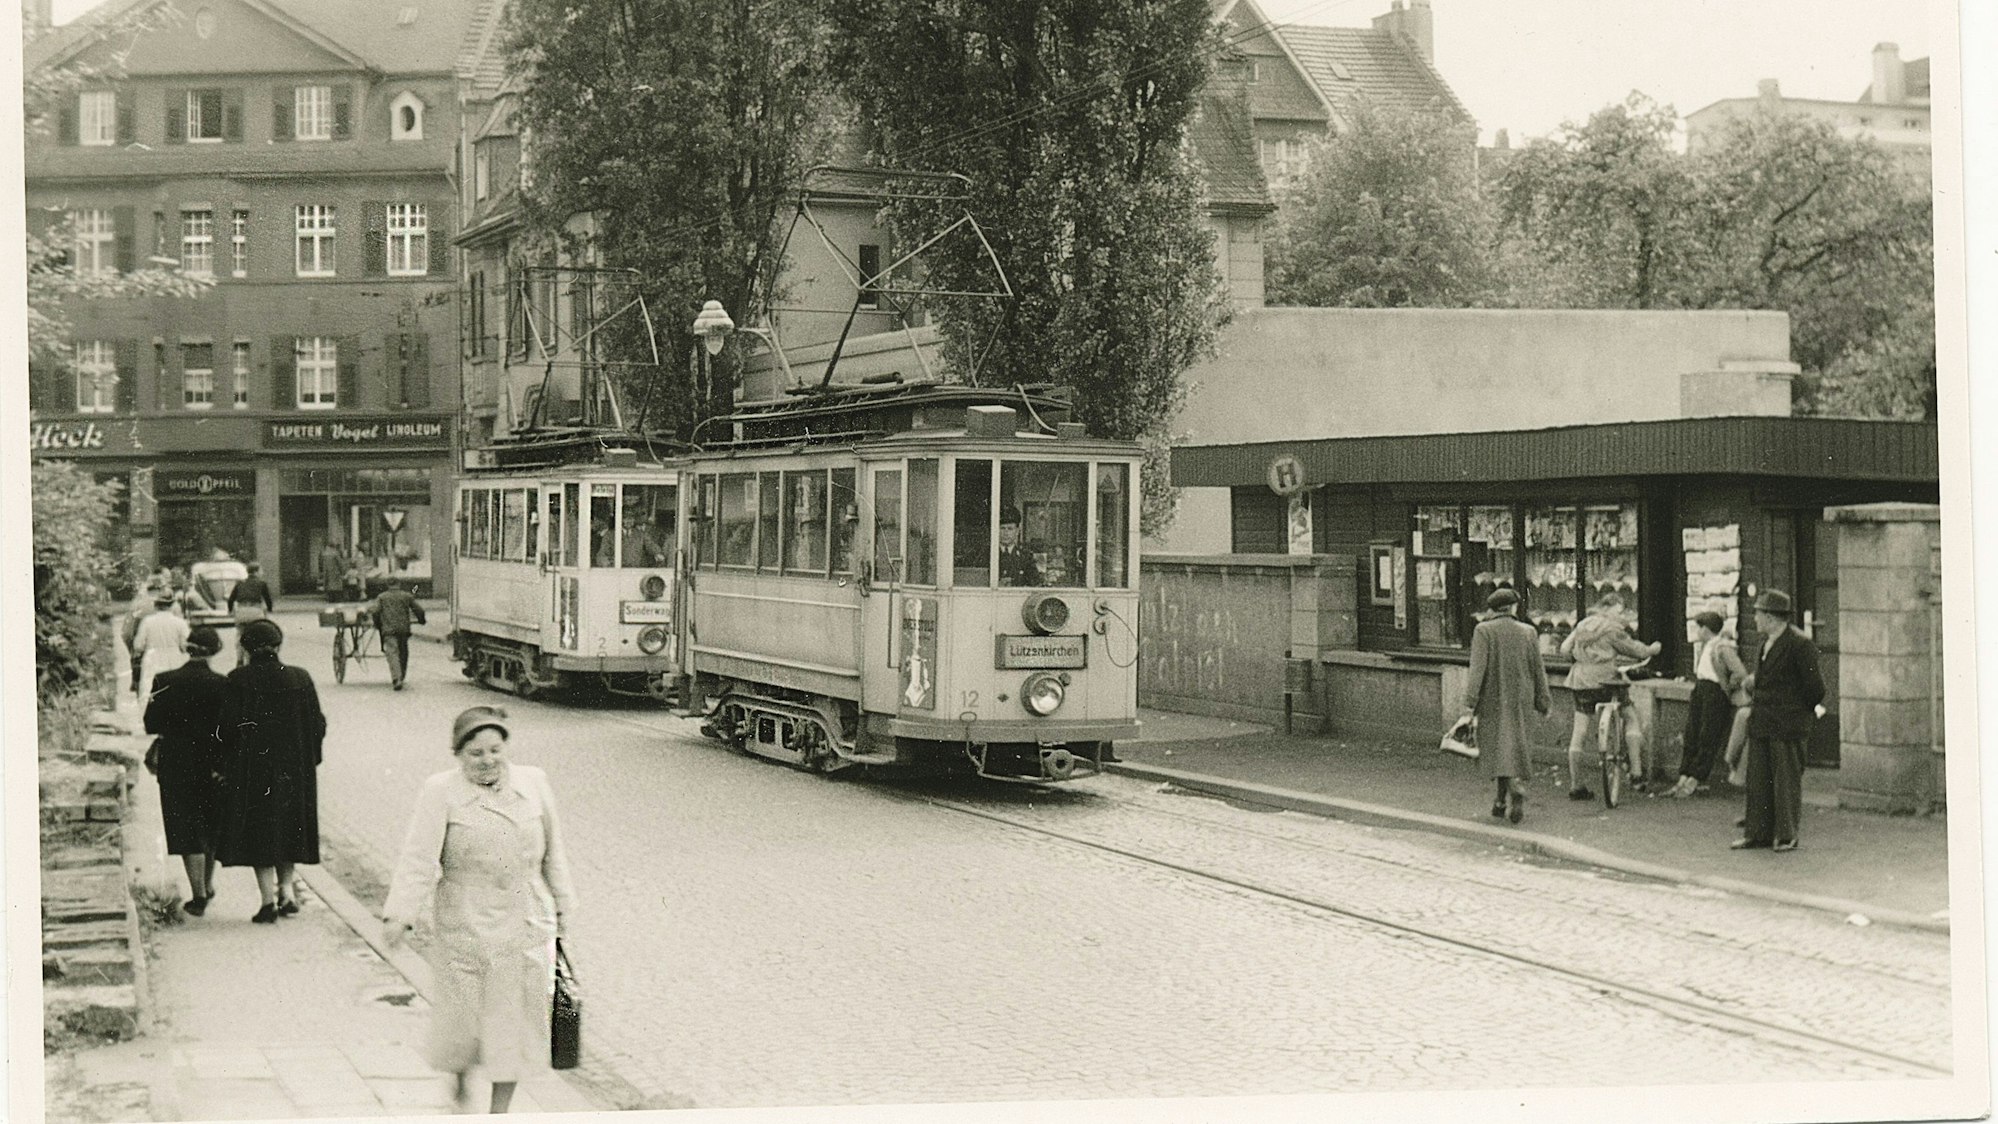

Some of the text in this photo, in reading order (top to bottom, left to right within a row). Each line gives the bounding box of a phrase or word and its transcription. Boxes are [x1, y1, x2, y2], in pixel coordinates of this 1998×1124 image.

[272, 423, 441, 442] TAPETEN Vogel LINOLEUM
[1276, 463, 1297, 488] H
[599, 637, 607, 650] 2
[960, 690, 979, 708] 12
